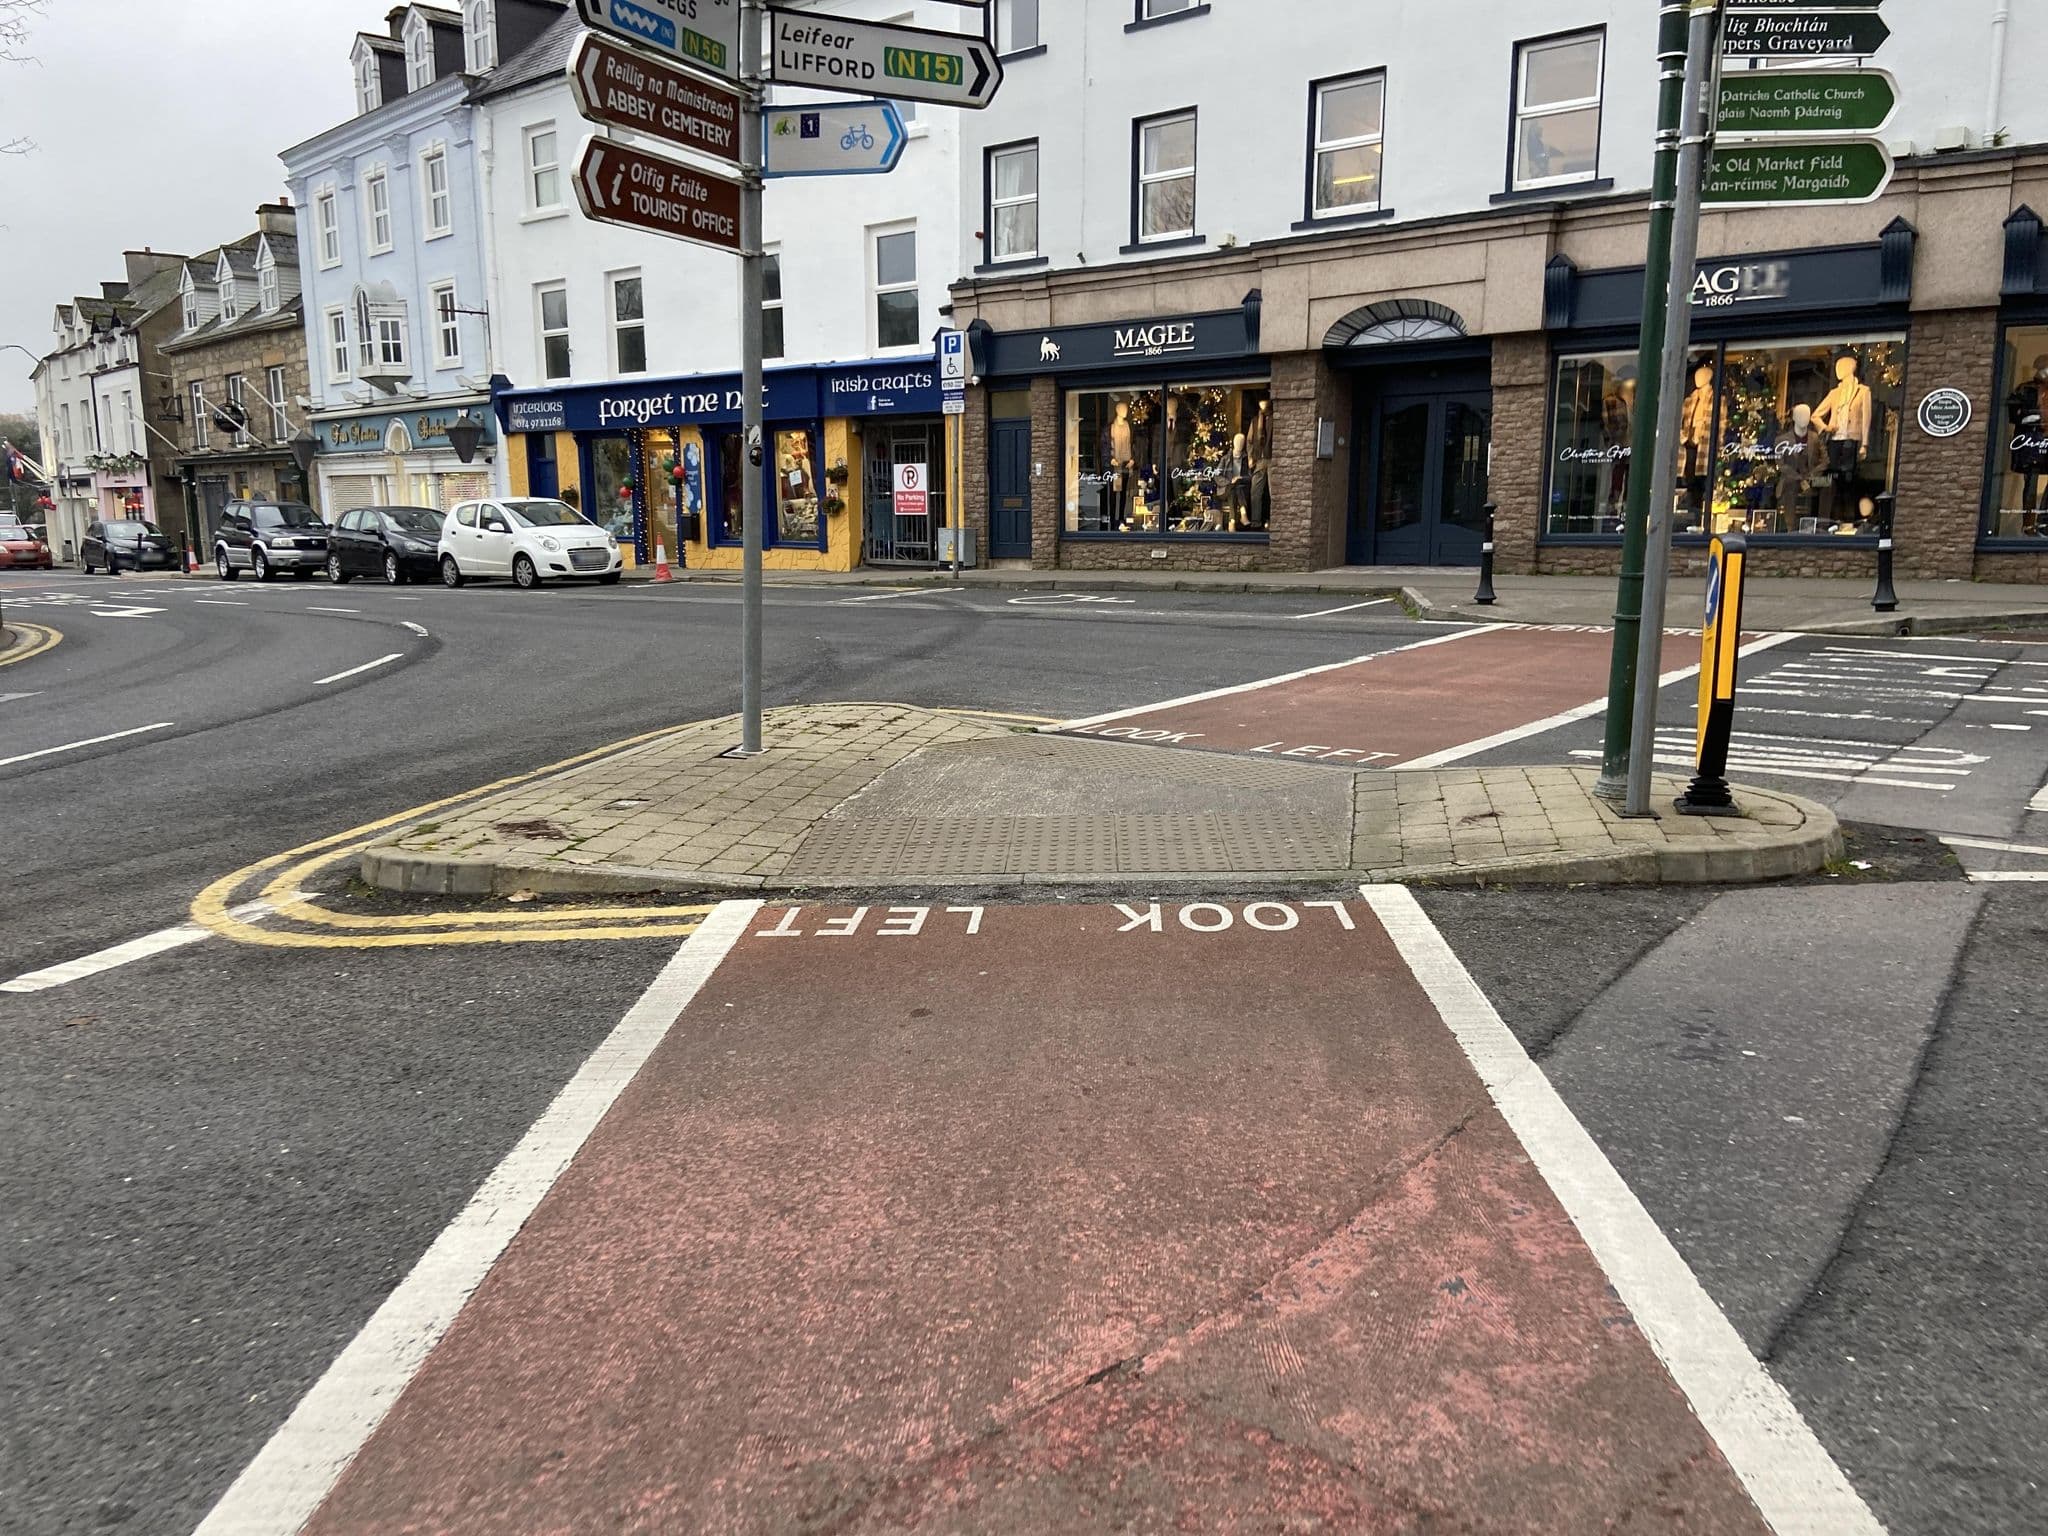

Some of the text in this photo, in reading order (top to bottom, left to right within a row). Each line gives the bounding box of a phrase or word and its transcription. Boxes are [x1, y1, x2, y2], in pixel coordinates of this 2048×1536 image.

[781, 22, 854, 50] Leifear
[1727, 16, 1829, 36] lig Bhochtán
[1767, 35, 1853, 55] Graveyard
[781, 51, 875, 80] LIFFORD
[887, 48, 961, 84] (N15)
[606, 56, 734, 121] Reillig na Mainistreach
[1721, 87, 1865, 104] Patricks Catholic Church
[607, 87, 732, 148] ABBEY CEMETERY
[1718, 107, 1745, 122] glais
[1749, 107, 1790, 121] Naomh
[1726, 157, 1750, 172] Old
[1756, 156, 1804, 174] Market
[1810, 154, 1843, 172] Field
[631, 162, 708, 202] Oifig Fáilte
[1783, 173, 1850, 193] Margaidh
[631, 191, 734, 237] TOURIST OFFICE
[1705, 294, 1734, 307] 1866
[1113, 322, 1195, 349] MAGEE
[1144, 346, 1163, 356] 1866
[1073, 723, 1400, 764] LOOK LEFT
[755, 901, 1356, 936] LOOK LEFT
